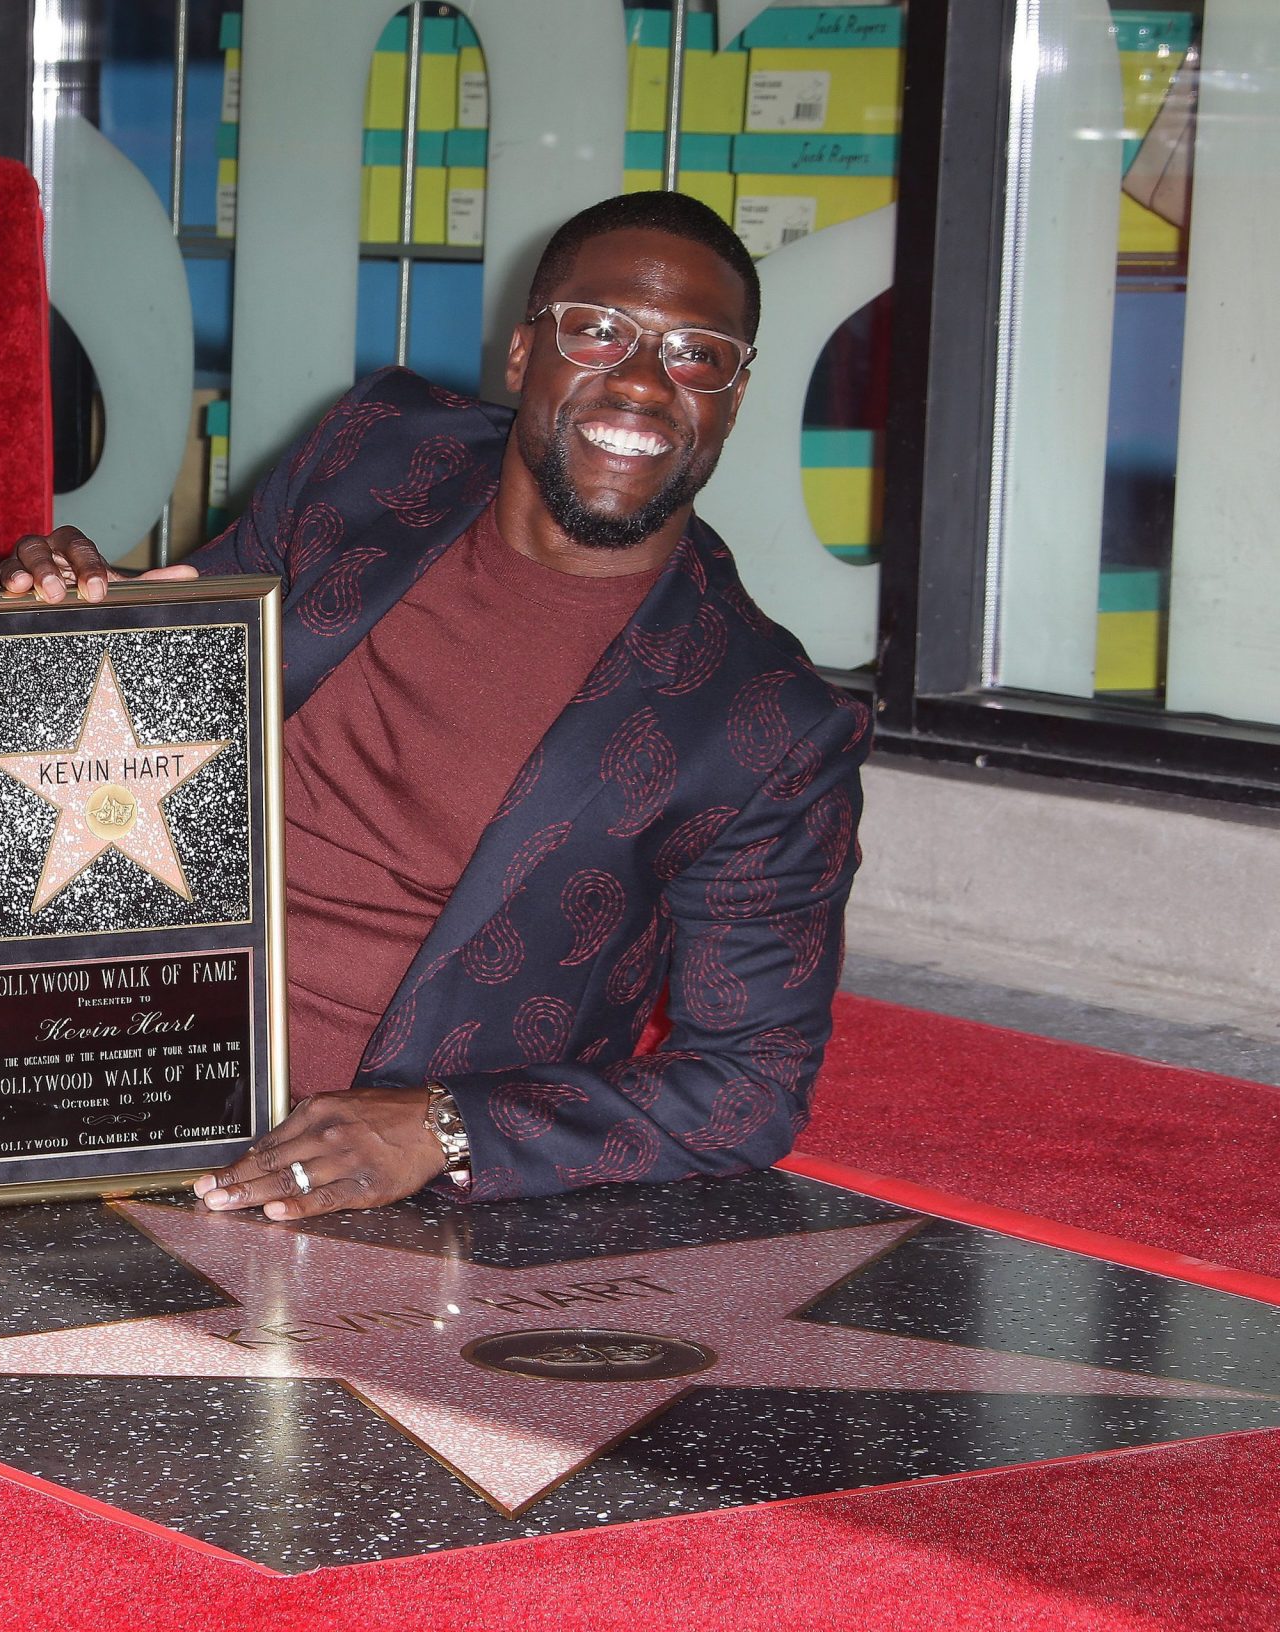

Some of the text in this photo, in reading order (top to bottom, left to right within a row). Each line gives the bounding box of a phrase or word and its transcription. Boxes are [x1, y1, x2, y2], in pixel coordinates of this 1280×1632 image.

[40, 754, 184, 785] KEVIN HART
[101, 966, 151, 989] WALK
[162, 964, 182, 986] OF
[193, 960, 238, 983] FAME
[139, 995, 151, 1003] TO
[35, 1011, 195, 1041] Kevin Hart
[5, 1057, 19, 1068] THE
[24, 1054, 60, 1067] OCCASION
[65, 1053, 75, 1063] OF
[80, 1052, 95, 1062] THE
[100, 1048, 142, 1060] PLACEMENT
[147, 1047, 157, 1057] OF
[162, 1045, 182, 1056] YOUR
[188, 1044, 207, 1054] STAR
[213, 1042, 221, 1052] IN
[226, 1041, 240, 1051] THE
[104, 1067, 153, 1087] WALK
[165, 1065, 184, 1082] OF
[195, 1060, 240, 1080] FAME
[142, 1090, 172, 1103] 2016
[78, 1132, 139, 1145] CHAMBER
[150, 1130, 164, 1140] OF
[174, 1123, 241, 1138] COMMERCE
[209, 1275, 677, 1350] KEVIN HART
